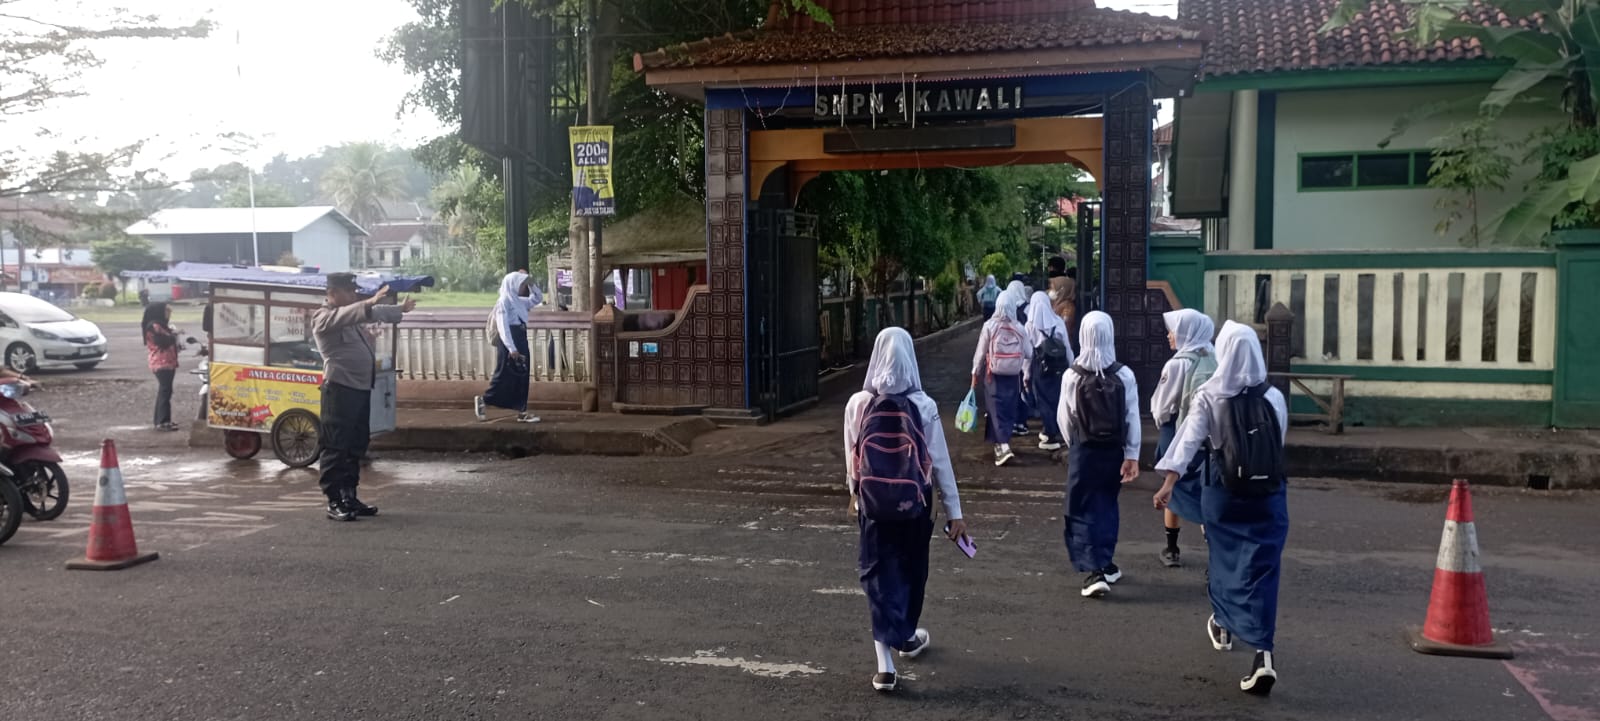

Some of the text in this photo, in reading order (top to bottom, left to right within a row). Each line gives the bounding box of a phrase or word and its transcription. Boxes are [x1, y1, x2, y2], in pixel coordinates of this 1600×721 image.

[816, 87, 1022, 116] SMPN 1 KAWALI
[578, 156, 607, 165] ALL IN
[248, 369, 318, 383] ANEKA GORINGAN
